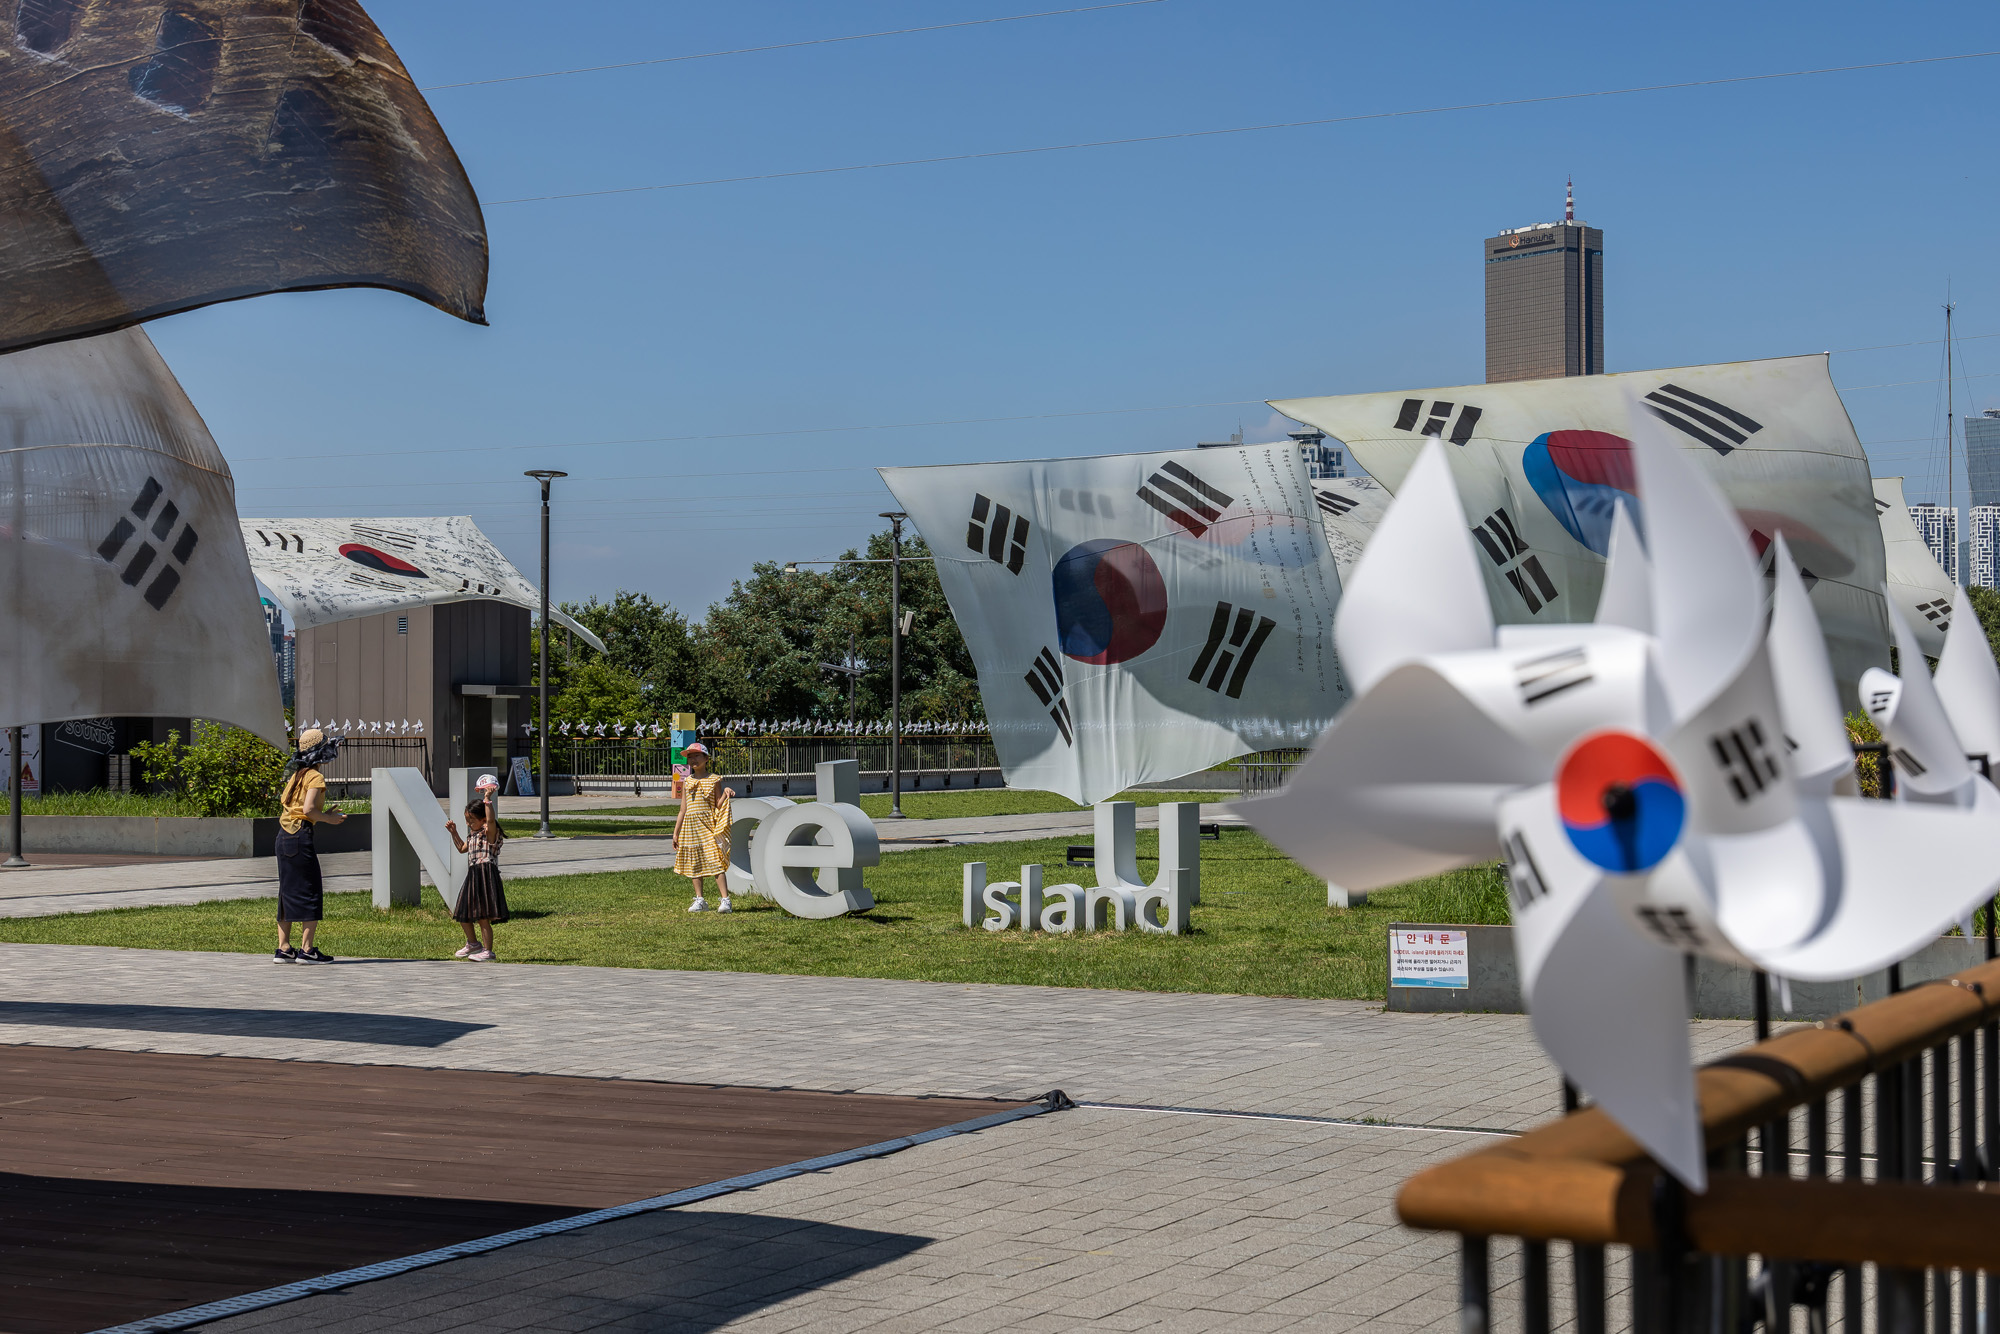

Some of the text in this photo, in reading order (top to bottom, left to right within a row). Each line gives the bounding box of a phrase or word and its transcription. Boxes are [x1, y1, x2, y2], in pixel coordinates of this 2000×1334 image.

[1520, 233, 1554, 244] Hanwha
[65, 720, 115, 748] SOUNDS
[963, 861, 1191, 936] Island
